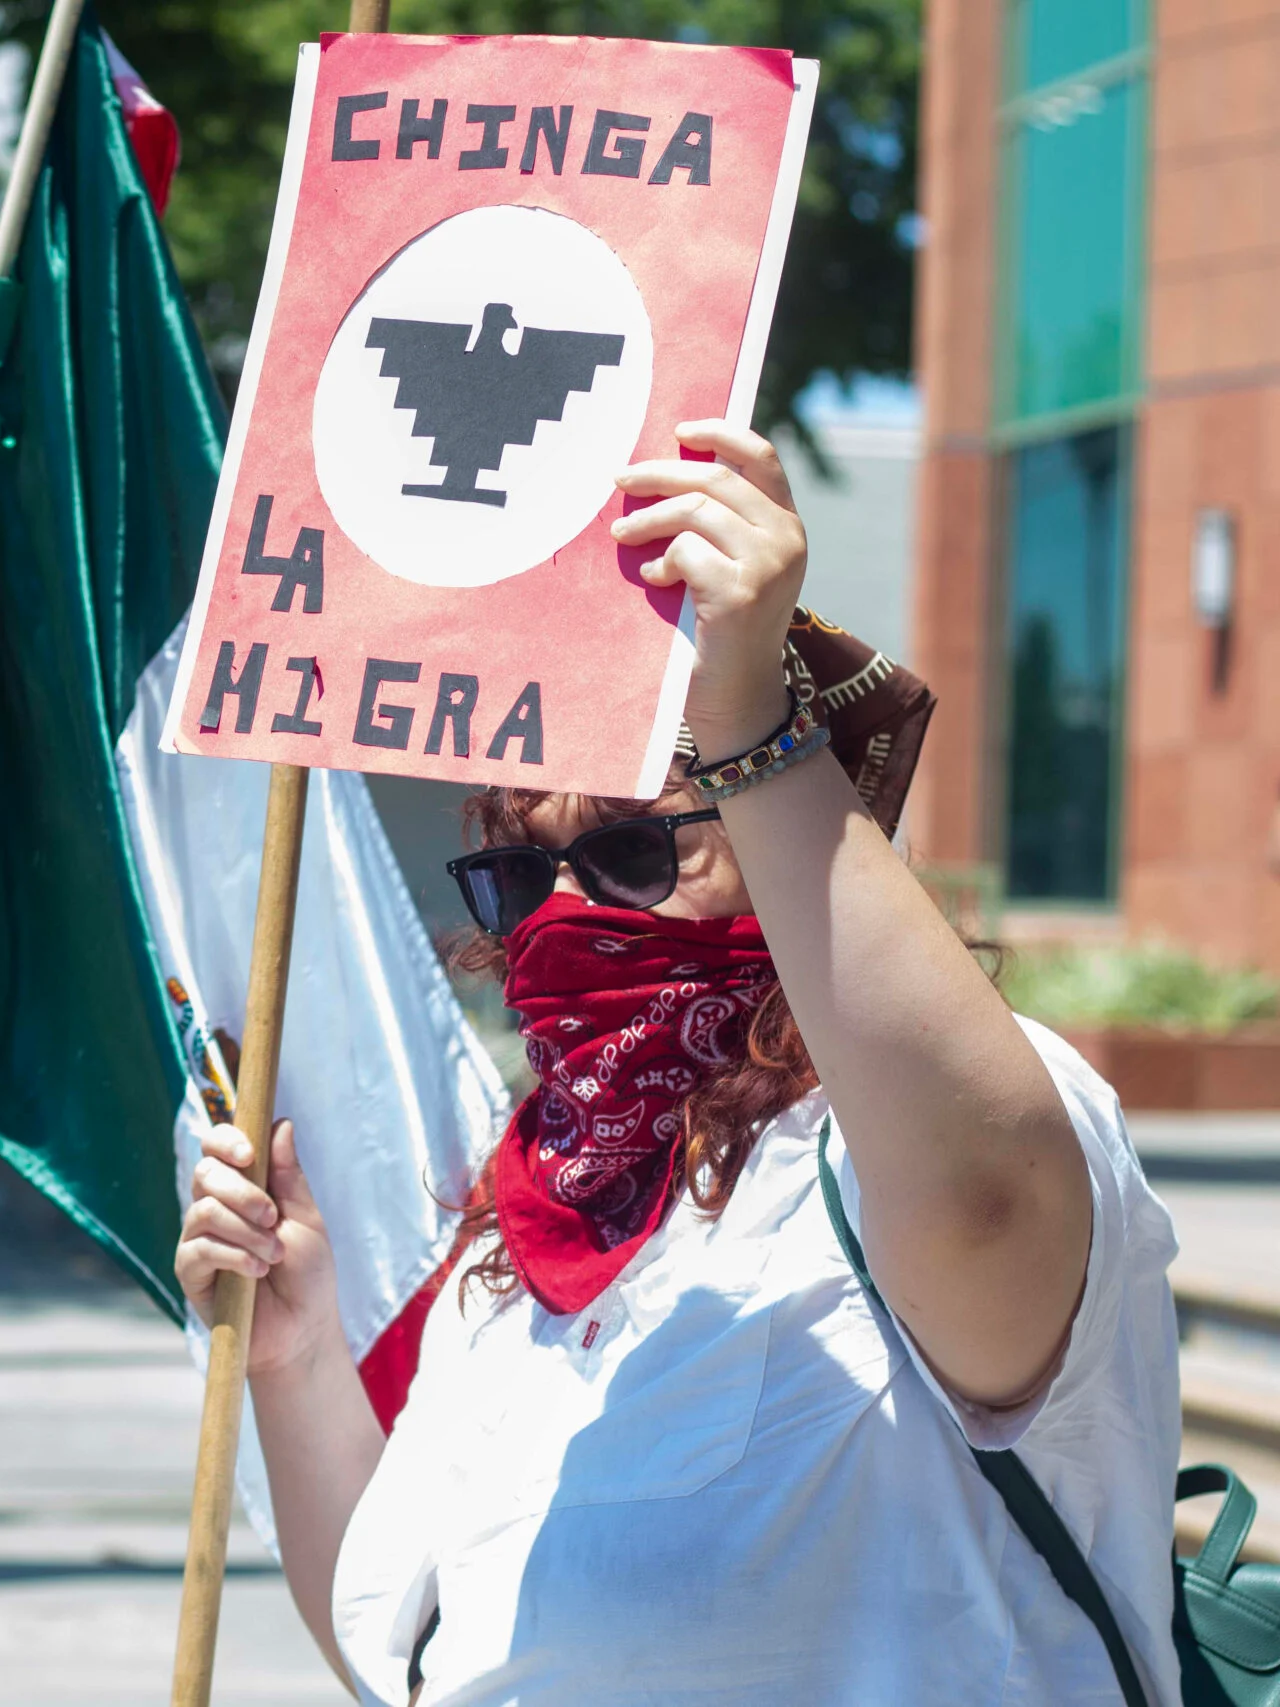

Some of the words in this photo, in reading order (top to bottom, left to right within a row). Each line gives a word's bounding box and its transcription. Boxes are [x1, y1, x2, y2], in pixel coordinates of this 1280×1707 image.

[330, 90, 714, 186] CHINGA
[241, 494, 325, 614] LA
[199, 640, 545, 765] MIGRA
